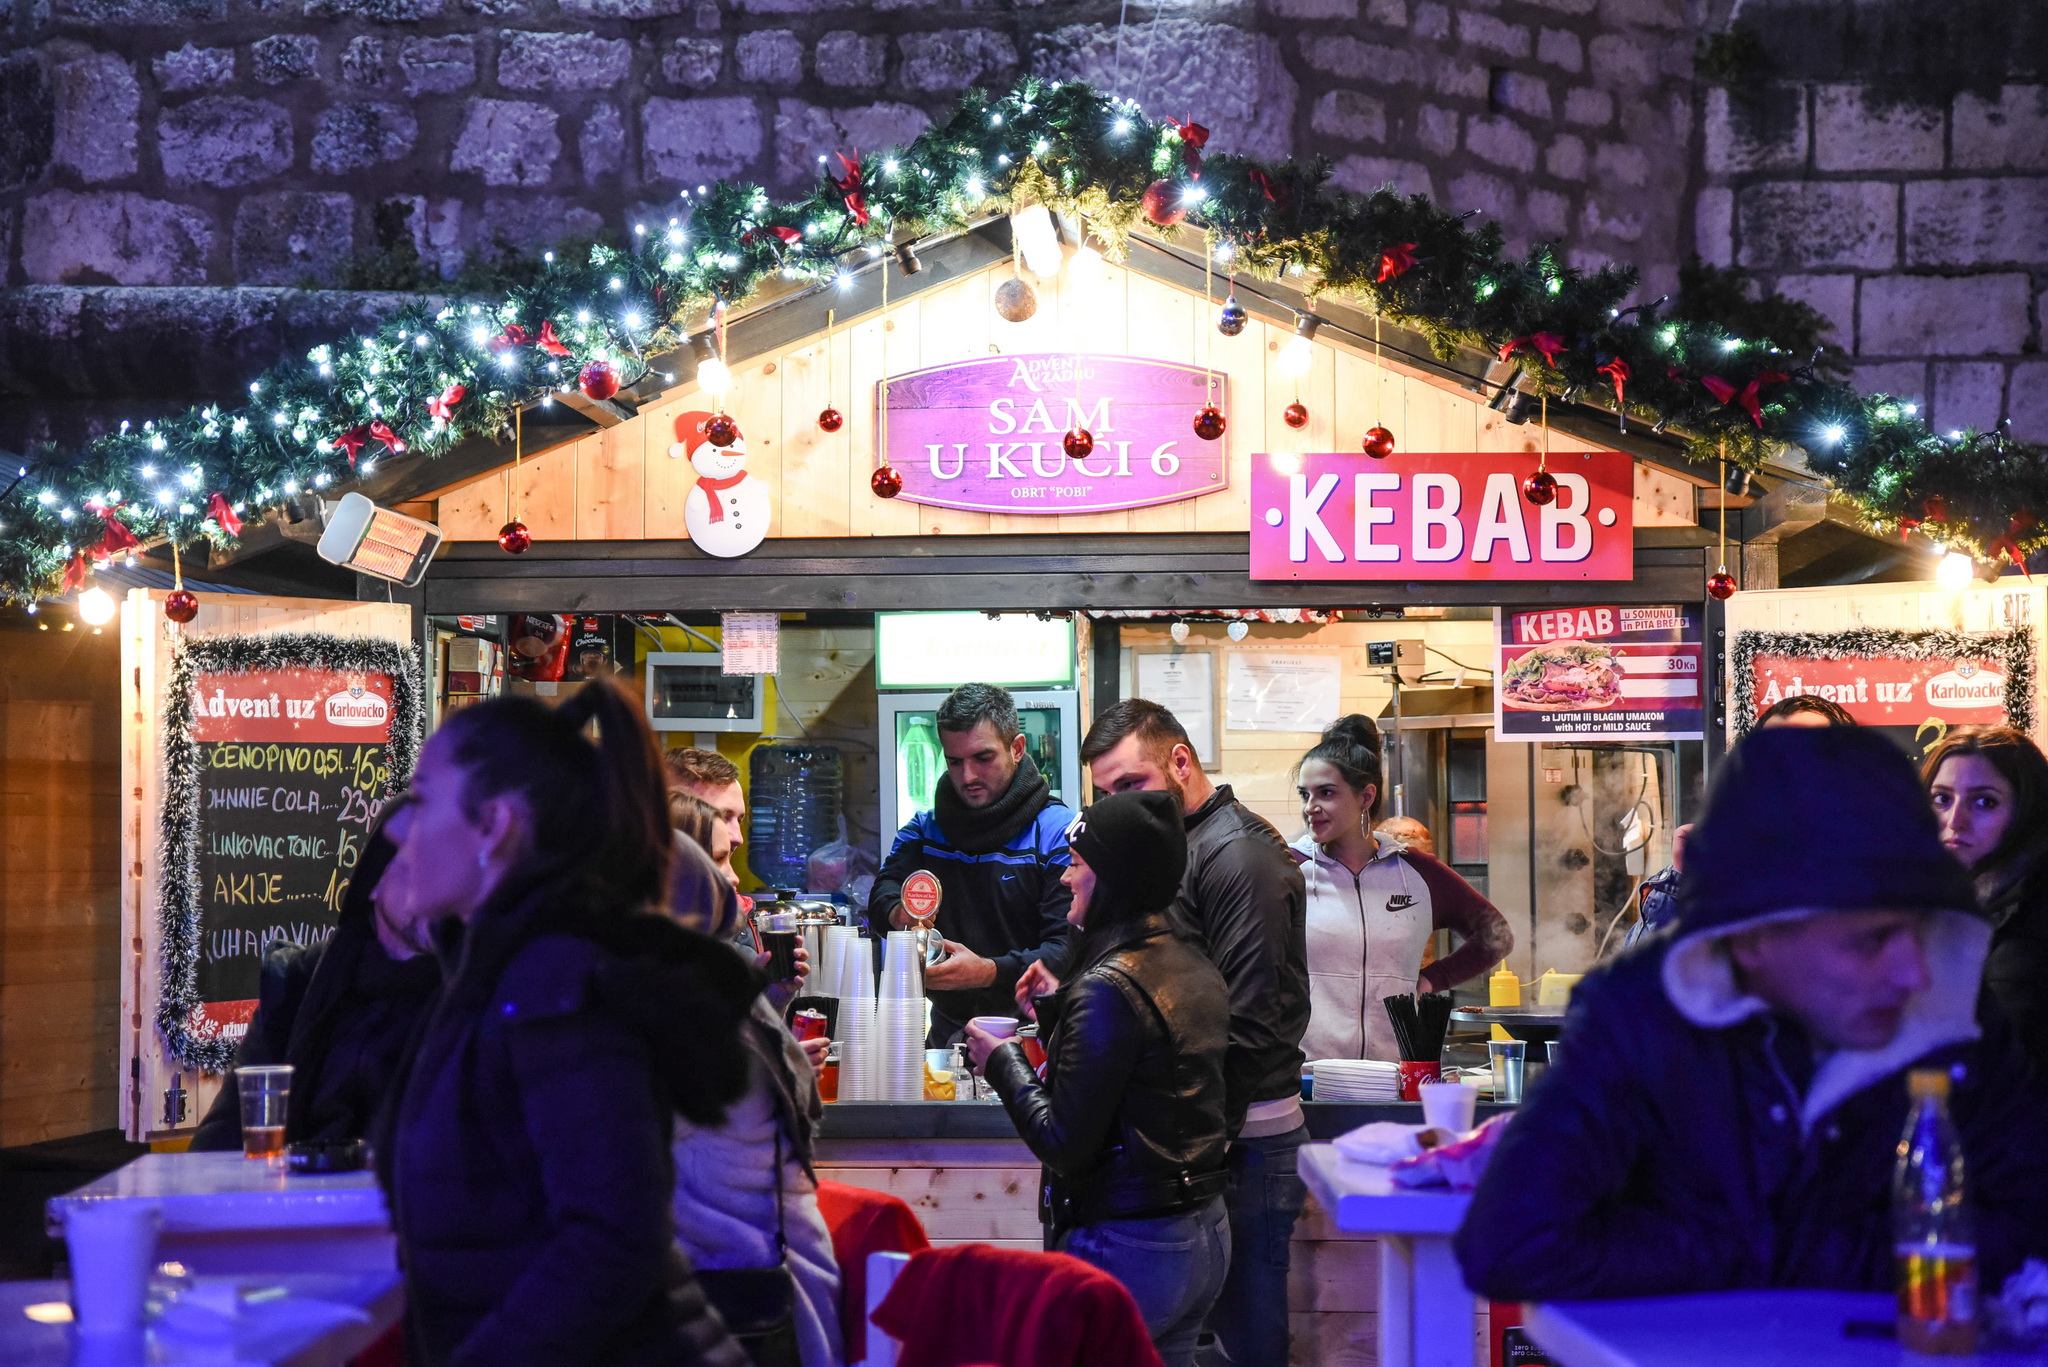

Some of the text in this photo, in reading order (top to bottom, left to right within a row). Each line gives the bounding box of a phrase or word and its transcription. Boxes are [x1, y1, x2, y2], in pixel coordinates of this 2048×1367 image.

[988, 397, 1115, 435] SAM
[925, 432, 1180, 480] U KUĆI 6
[1010, 486, 1047, 498] OBRT
[1288, 472, 1594, 563] KEBAB
[1623, 618, 1687, 630] in PITA BREAD
[1624, 609, 1673, 619] u SOMUNU
[1519, 608, 1615, 642] KEBAB
[575, 636, 607, 648] Chocolate
[1760, 677, 1869, 705] Advent
[1876, 681, 1913, 703] uz
[191, 688, 385, 719] Advent uz Karlovačko
[1552, 712, 1582, 722] LJUTIM
[1583, 712, 1592, 721] ili
[1593, 712, 1625, 722] BLAGIM
[1626, 712, 1665, 721] UMAKOM
[1555, 722, 1651, 732] with HOT or MILD SAUCE
[207, 830, 285, 860] LINKOVAC
[1389, 894, 1413, 905] NIKE
